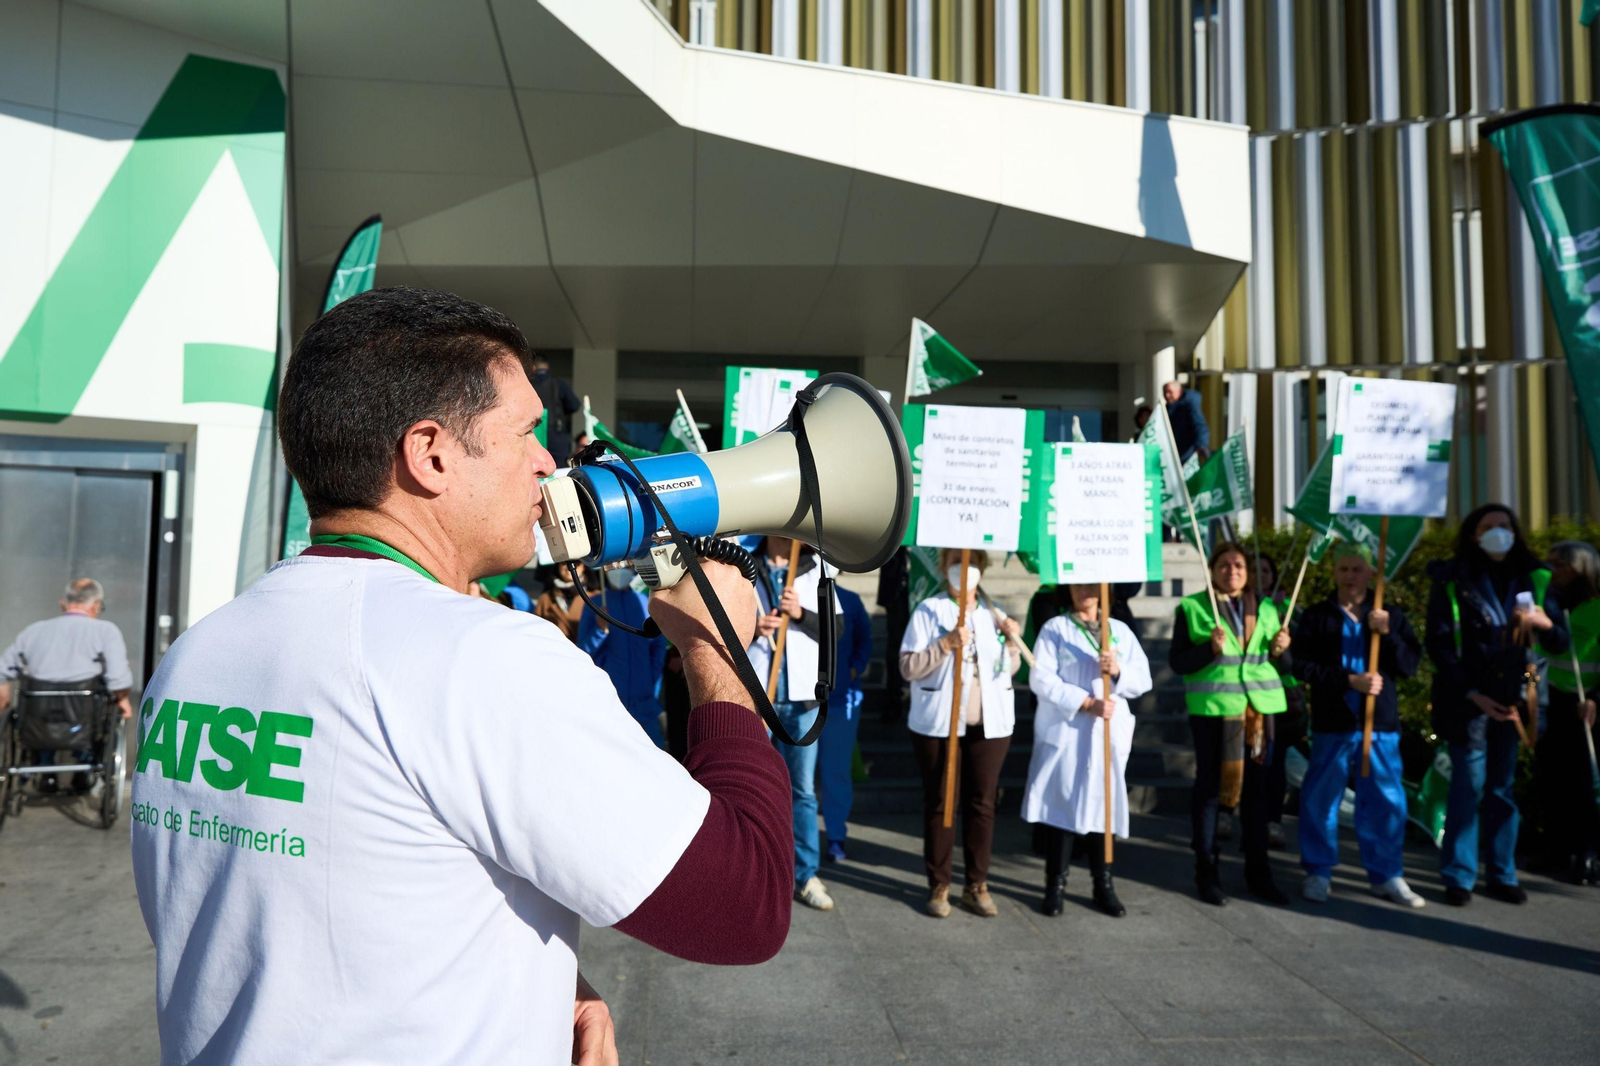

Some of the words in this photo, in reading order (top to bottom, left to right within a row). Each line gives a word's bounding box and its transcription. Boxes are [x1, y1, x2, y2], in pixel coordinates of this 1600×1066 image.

[932, 433, 956, 441] Miles
[959, 434, 969, 442] de
[972, 435, 1014, 445] contratos
[944, 446, 955, 454] de
[958, 448, 1001, 456] sanitarios
[946, 460, 986, 469] terminan
[989, 461, 998, 469] el
[943, 483, 953, 491] 31
[956, 484, 966, 492] de
[958, 513, 979, 522] YA!
[1067, 519, 1101, 528] AHORA
[1074, 533, 1109, 541] FALTAN
[1074, 547, 1129, 556] CONTRATOS
[163, 805, 182, 832] de
[188, 810, 305, 857] Enfermería
